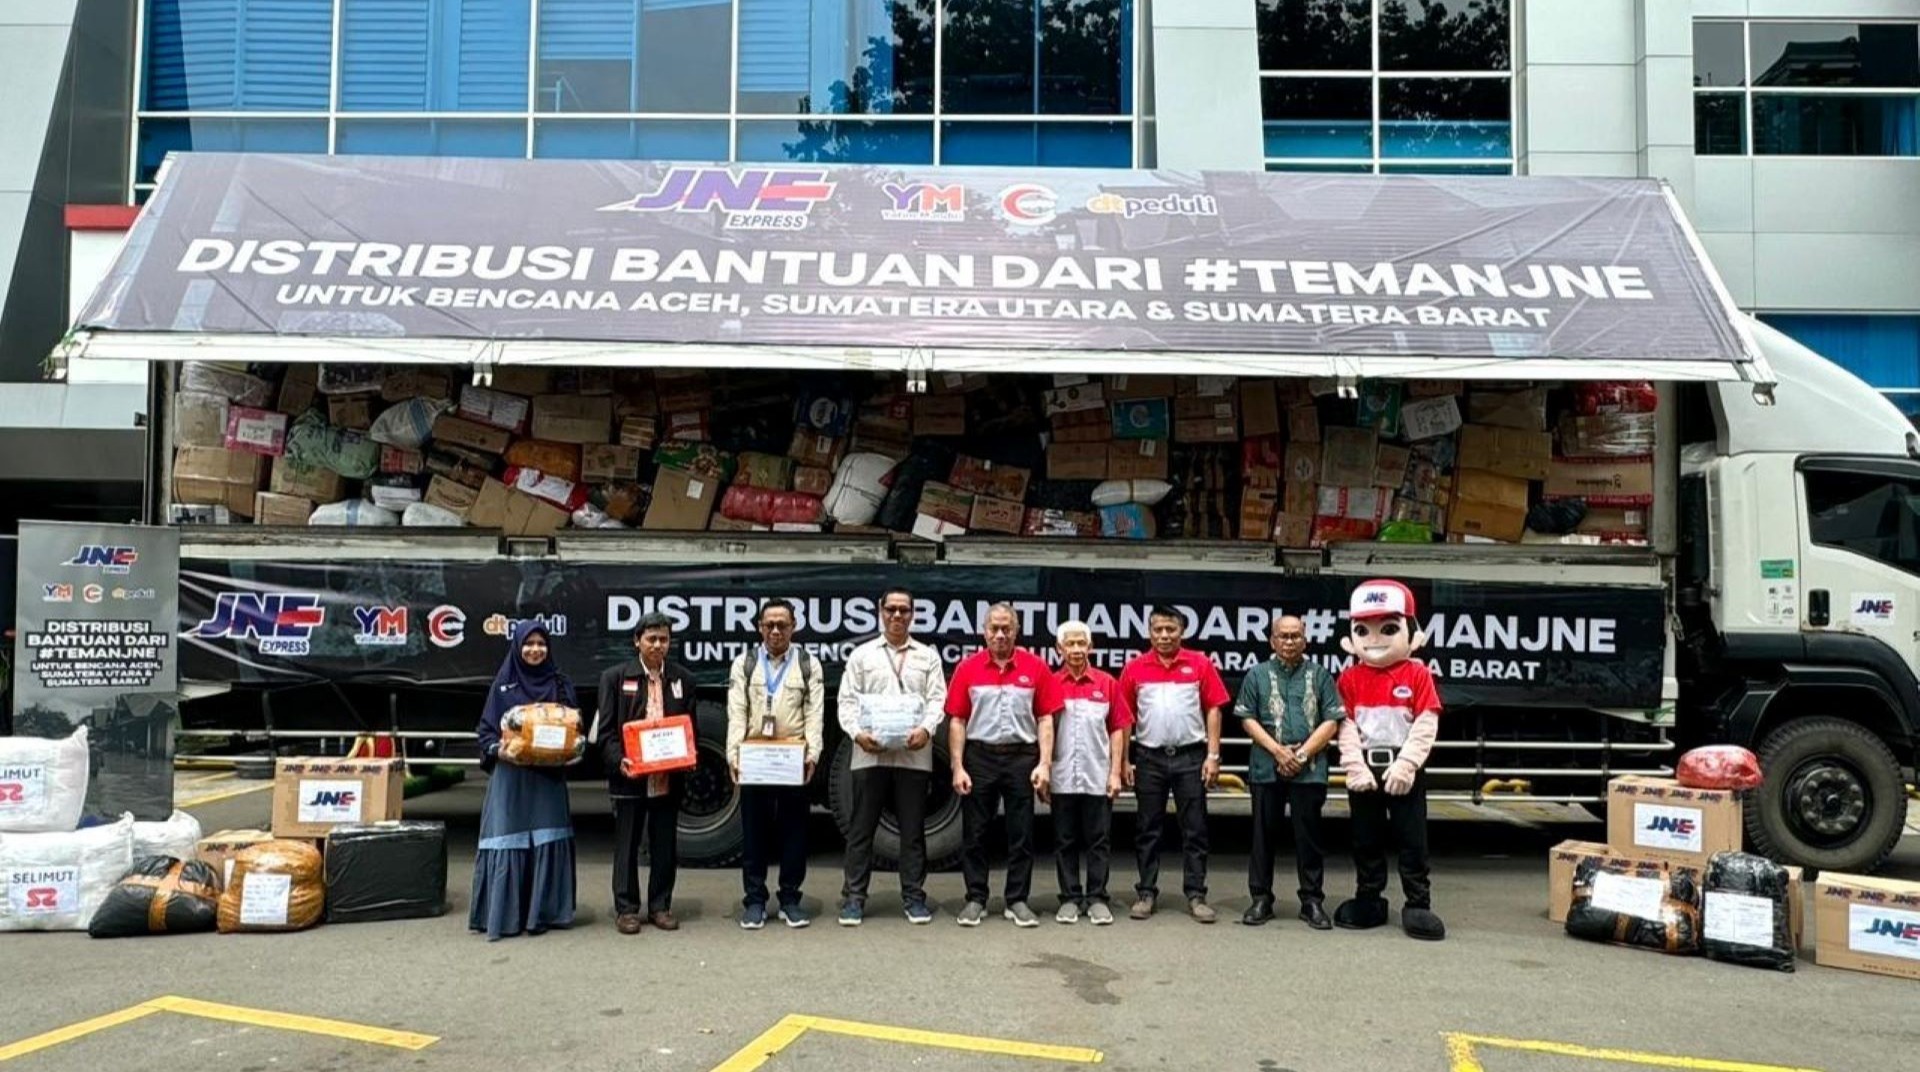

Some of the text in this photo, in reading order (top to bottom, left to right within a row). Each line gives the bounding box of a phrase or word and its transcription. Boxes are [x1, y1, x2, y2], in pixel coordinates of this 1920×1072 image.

[628, 167, 837, 213] JNE
[882, 183, 964, 211] YM
[729, 214, 804, 229] EXPRESS
[177, 238, 1655, 300] DISTRIBUSI BANTUAN DARI #TEMANJNE
[276, 284, 1552, 328] UNTUK BENCANA ACEH, SUMATERA UTARA & SUMATERA BARAT
[66, 545, 138, 566] JNE
[1855, 600, 1893, 614] JNE
[198, 592, 326, 638] JNE
[353, 606, 408, 635] YM
[48, 621, 149, 633] DISTRIBUSI
[28, 634, 166, 646] BANTUAN DARI
[262, 640, 309, 653] EXPRESS
[39, 647, 156, 659] #TEMANJNE
[32, 662, 72, 670] UNTUK
[74, 662, 126, 670] BENCANA
[1450, 658, 1541, 681] BARAT
[41, 670, 103, 679] SUMATERA
[106, 670, 143, 678] UTARA
[46, 678, 146, 687] SUMATERA BARAT
[309, 791, 357, 806] JNE
[1646, 815, 1696, 834] JNE
[12, 870, 75, 884] SELIMUT
